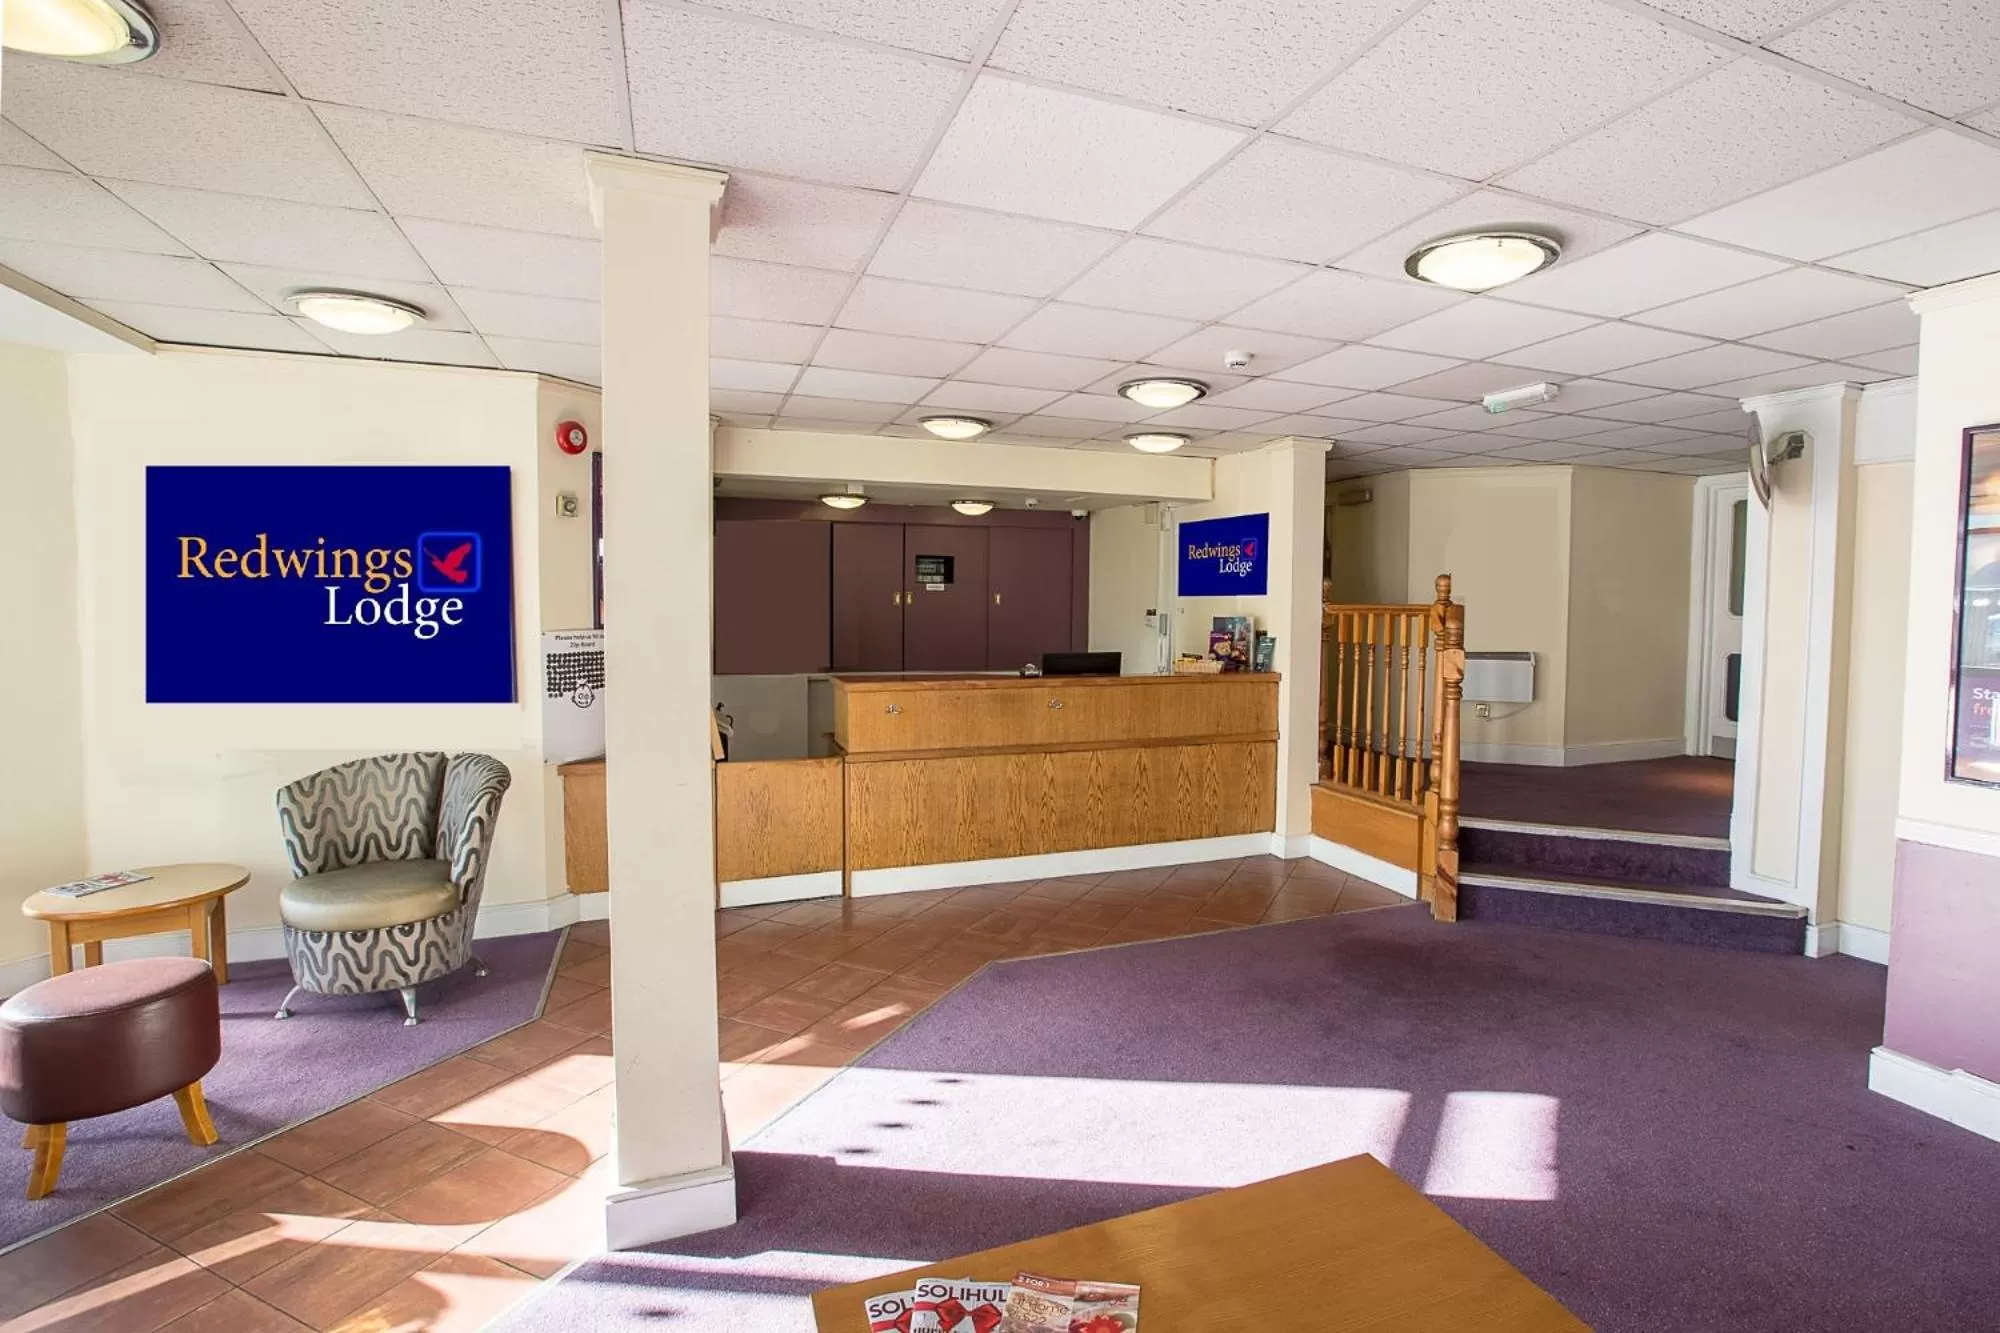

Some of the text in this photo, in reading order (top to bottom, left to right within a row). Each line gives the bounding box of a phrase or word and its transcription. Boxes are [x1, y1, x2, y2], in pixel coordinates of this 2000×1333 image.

[1188, 542, 1241, 561] Redwings
[177, 533, 413, 593] Redwings
[1219, 557, 1253, 577] Lodge
[324, 583, 463, 639] Lodge
[1025, 1277, 1044, 1288] FOR
[869, 1295, 915, 1318] SOL
